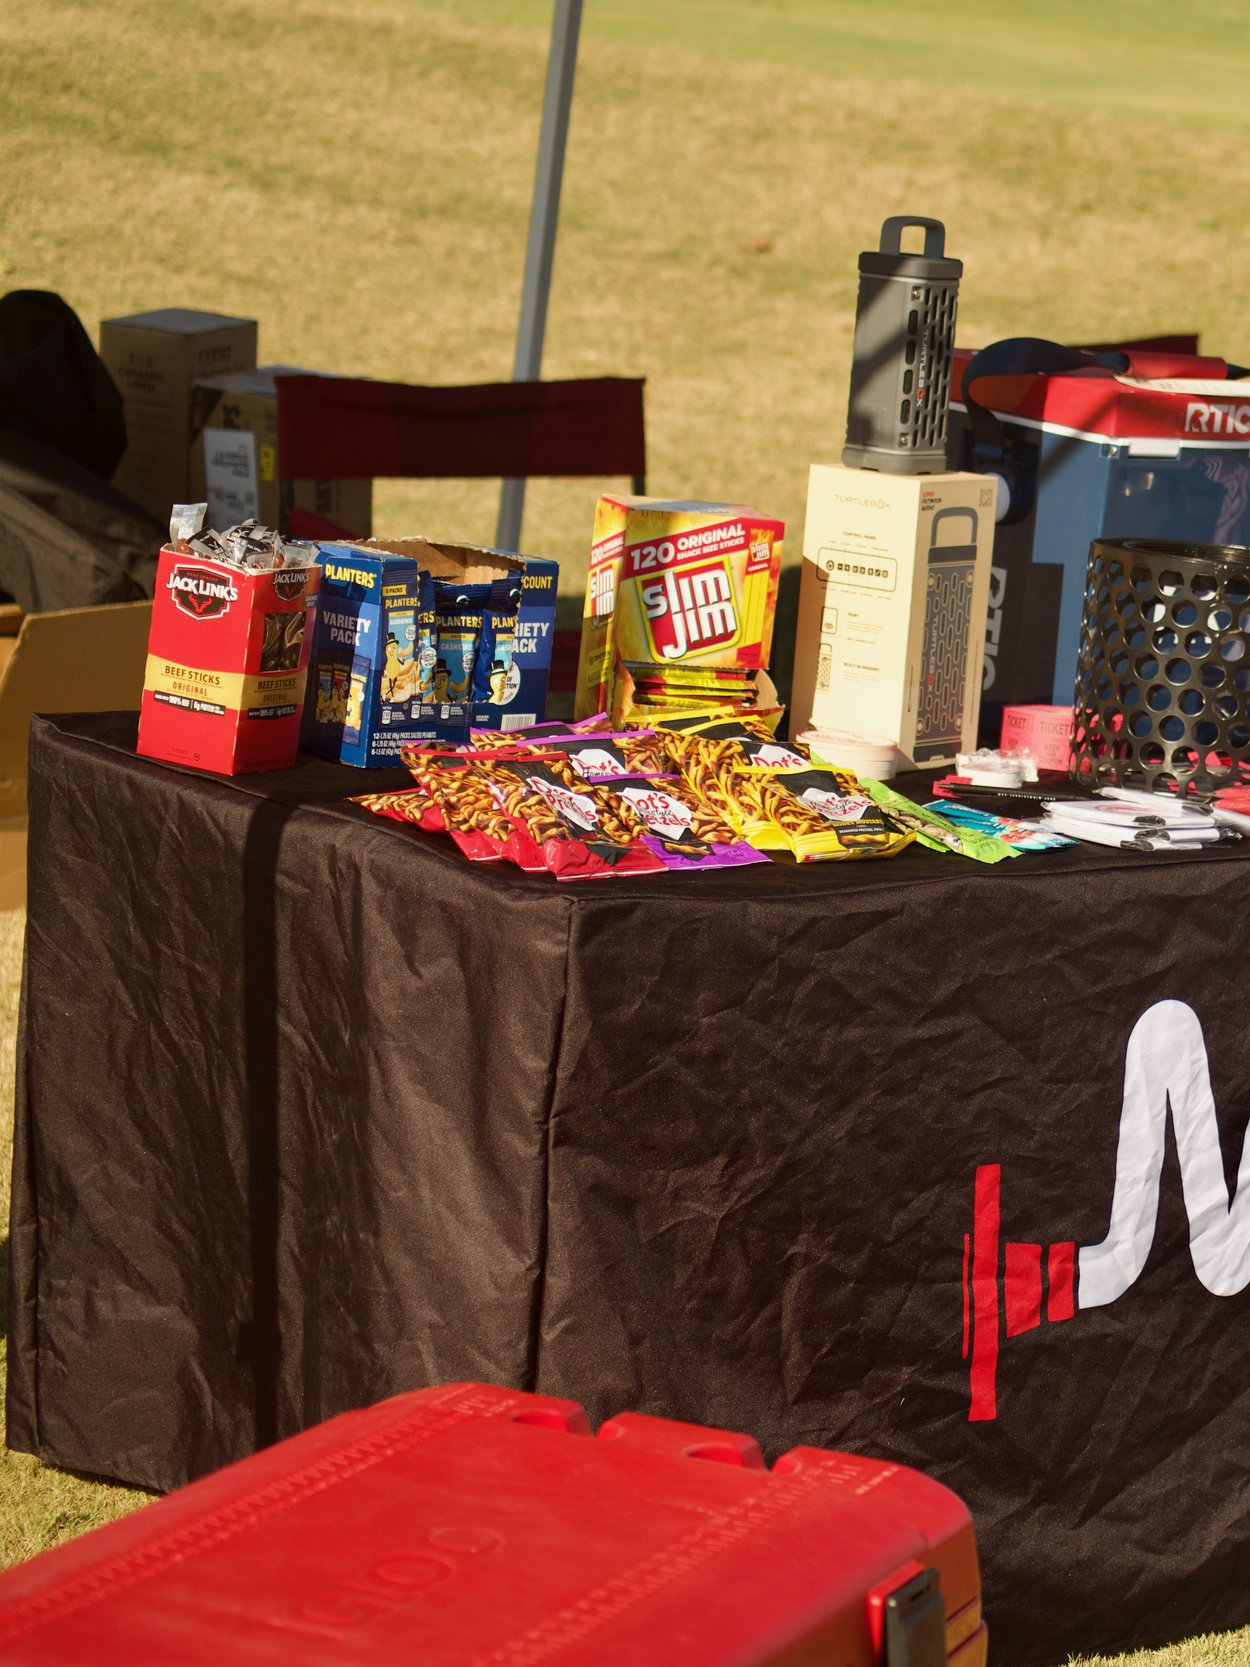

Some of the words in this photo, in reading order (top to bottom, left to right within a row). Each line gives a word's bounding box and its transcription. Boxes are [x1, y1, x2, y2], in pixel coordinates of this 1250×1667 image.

[916, 329, 929, 408] TURTLEBOX
[677, 523, 746, 551] ORIGINAL
[630, 542, 675, 571] 120
[676, 548, 702, 561] SNACK
[702, 544, 718, 557] SIZE
[719, 536, 745, 551] STICKS
[273, 573, 291, 585] JACK
[325, 563, 376, 589] PLANTERS
[523, 576, 553, 589] COUNT
[166, 573, 199, 596] JACK
[385, 597, 418, 610] PLANTERS
[322, 610, 372, 634] VARIETY
[436, 616, 483, 629] PLANTERS
[330, 627, 361, 647] PACK
[511, 638, 537, 654] ACK
[164, 665, 187, 679] BEEF
[187, 670, 221, 686] STICKS
[172, 681, 208, 697] ORIGINAL
[257, 681, 274, 690] BEEF
[274, 678, 296, 689] STICKS
[262, 693, 288, 702] ORIGINAL
[1007, 715, 1026, 730] TICKET
[1040, 720, 1070, 736] TICKET
